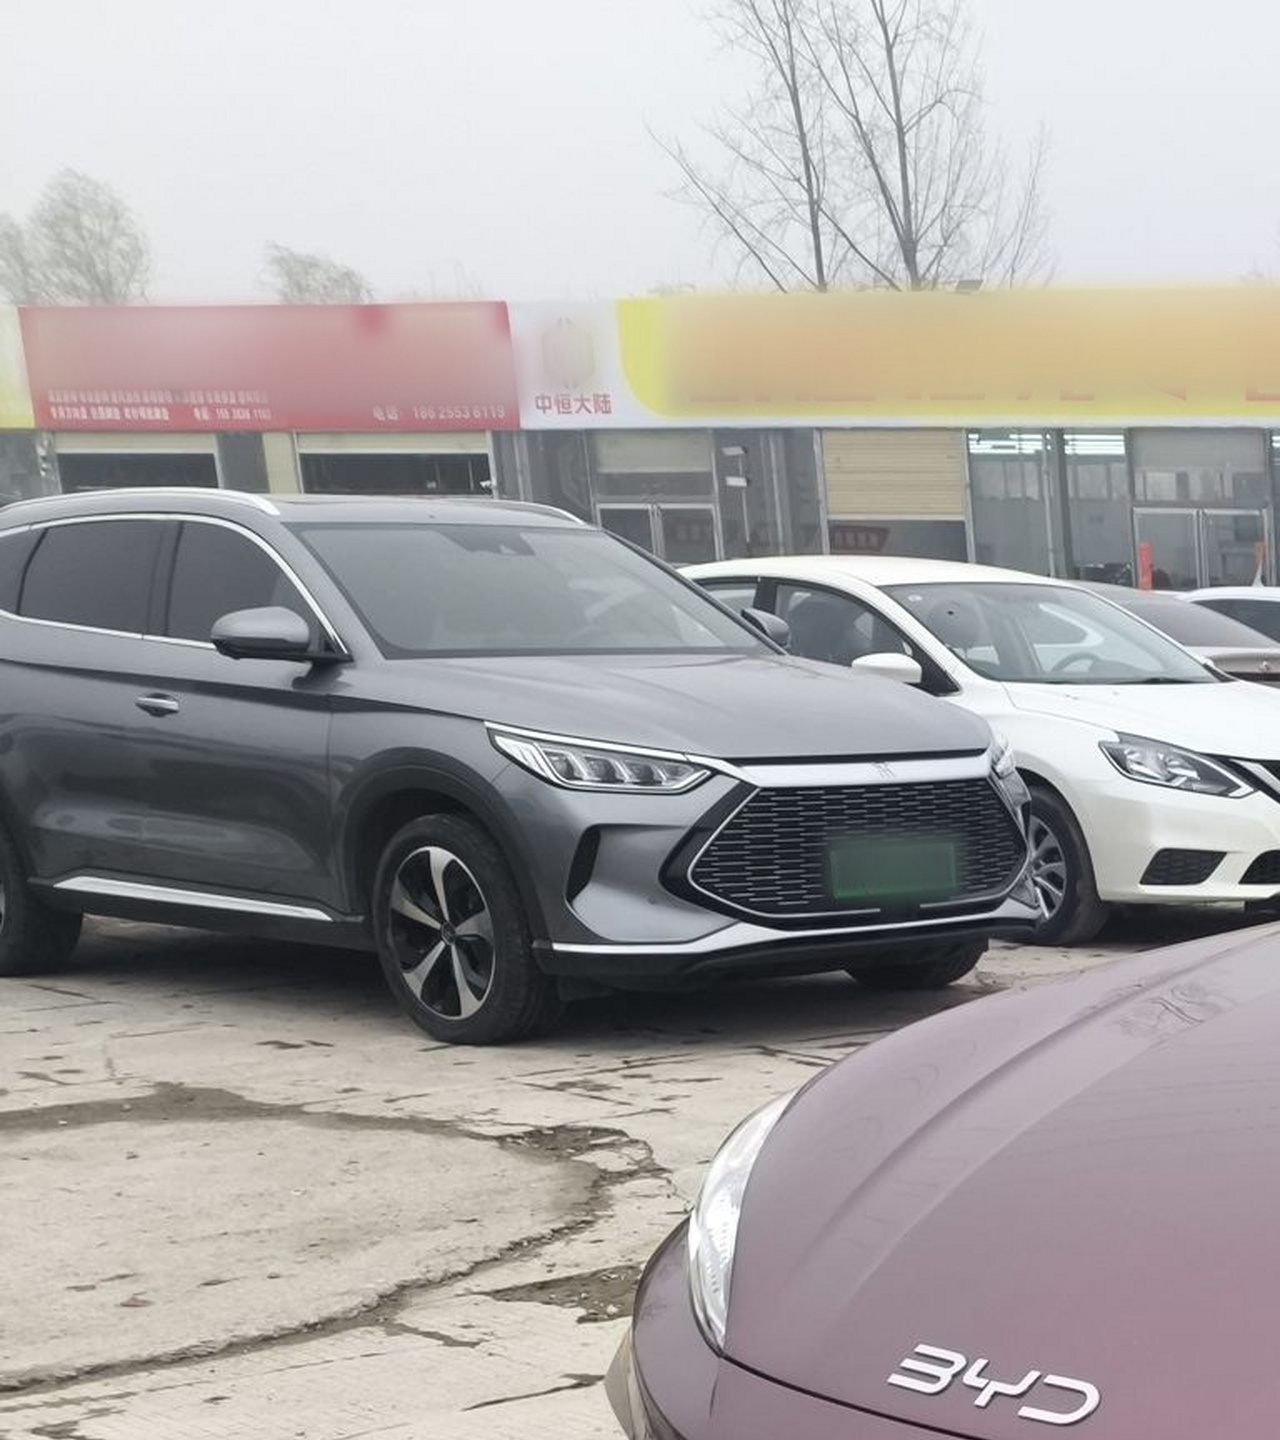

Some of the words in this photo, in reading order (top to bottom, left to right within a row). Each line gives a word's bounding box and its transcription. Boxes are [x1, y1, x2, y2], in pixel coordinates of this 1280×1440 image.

[535, 394, 612, 415] 中恒大陆
[887, 1343, 1100, 1425] BYD
